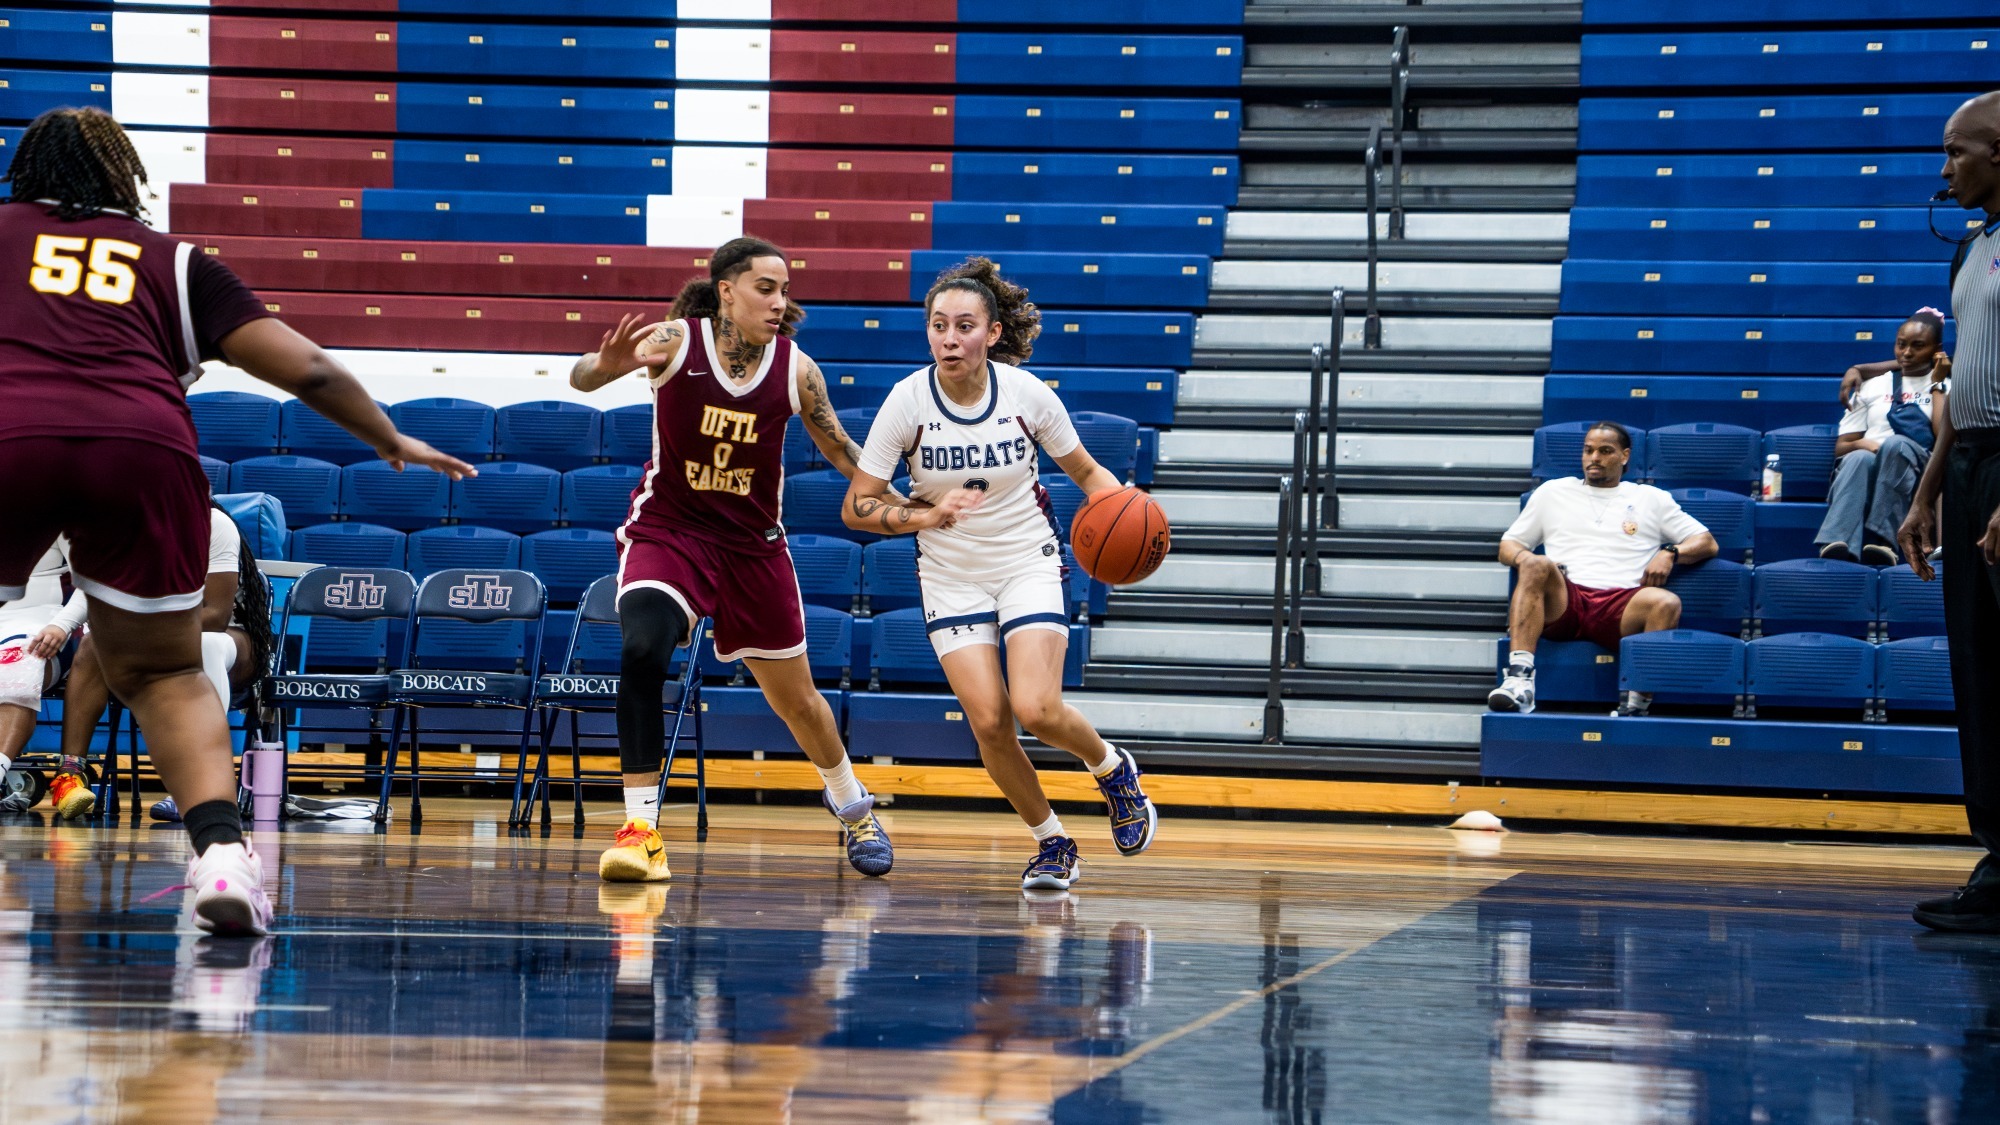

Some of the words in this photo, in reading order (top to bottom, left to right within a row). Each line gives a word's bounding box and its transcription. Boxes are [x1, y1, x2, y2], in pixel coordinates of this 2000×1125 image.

[29, 234, 142, 305] 55
[700, 404, 758, 443] UFTL
[714, 442, 733, 468] 0
[920, 437, 1025, 471] BOBCATS
[324, 573, 387, 610] STU
[448, 575, 513, 610] STU
[275, 680, 360, 699] BOBCATS
[402, 674, 486, 691] BOBCATS
[550, 678, 620, 694] BOBCAT
